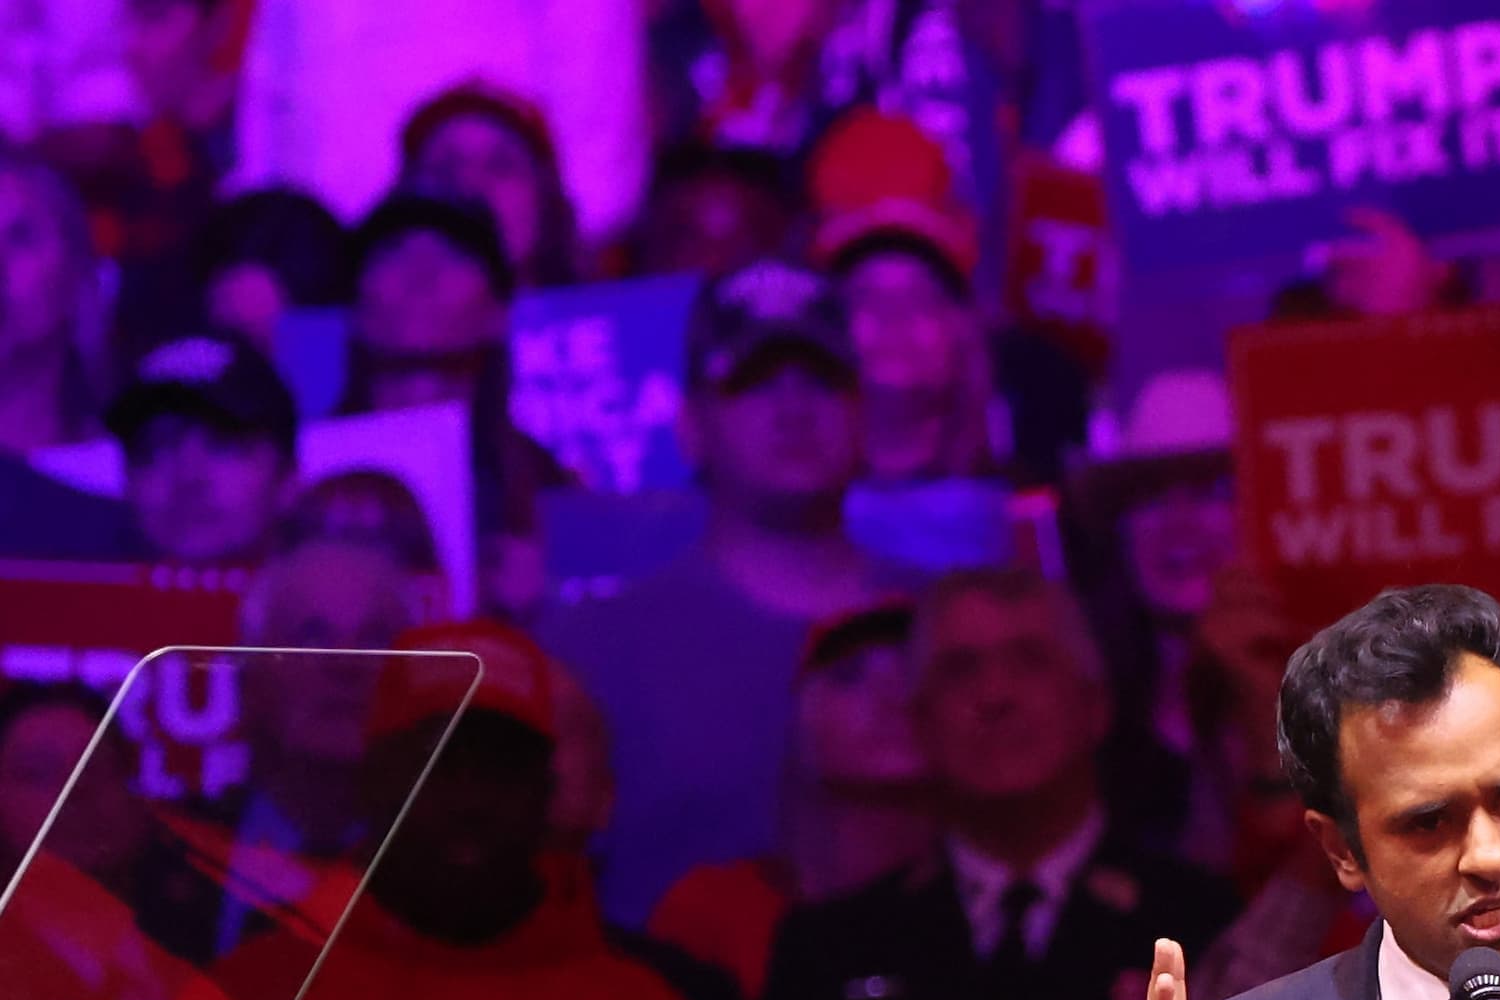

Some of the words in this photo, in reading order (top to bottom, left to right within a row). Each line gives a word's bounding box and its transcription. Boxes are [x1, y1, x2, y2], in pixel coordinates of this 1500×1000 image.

[1127, 140, 1320, 217] WILL
[1328, 119, 1450, 191] FIX
[1270, 500, 1467, 566] WILL
